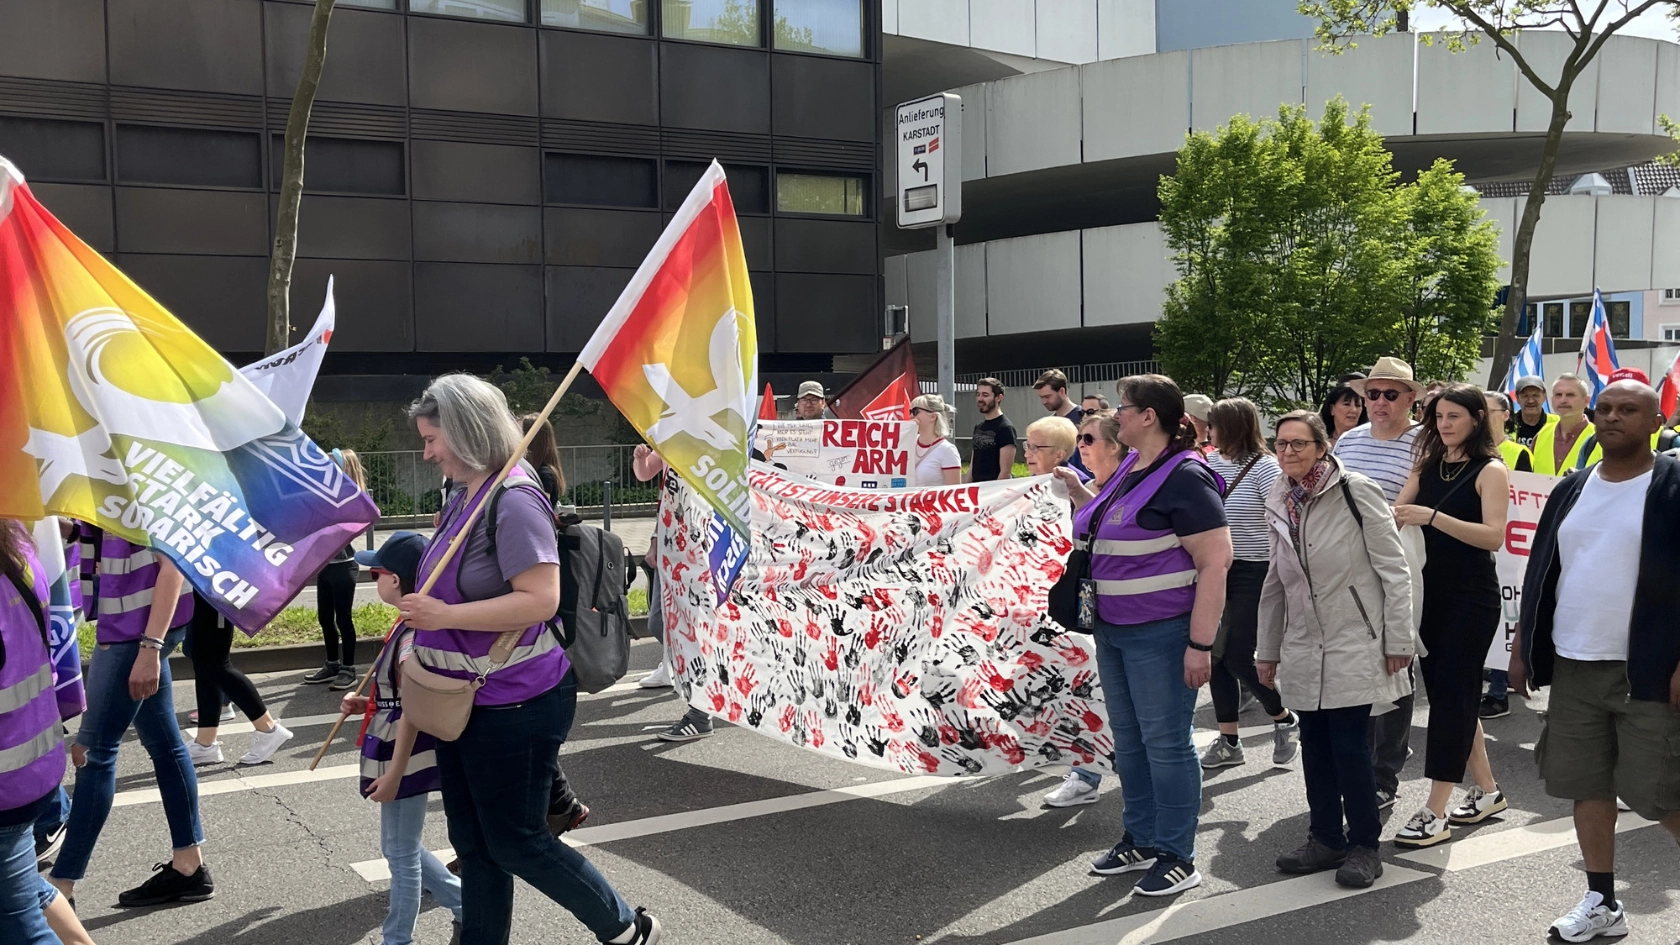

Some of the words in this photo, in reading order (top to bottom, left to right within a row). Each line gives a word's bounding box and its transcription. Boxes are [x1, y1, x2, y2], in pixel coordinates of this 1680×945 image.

[898, 107, 945, 125] Anlieferung
[903, 125, 940, 141] KARSTADT
[823, 421, 900, 449] REICH
[852, 449, 907, 475] ARM
[125, 441, 294, 567] VIELFÄLTIG
[128, 472, 225, 549] STARK
[775, 482, 818, 499] IST
[809, 490, 883, 511] UNSERE
[884, 486, 979, 514] STÄRKE!
